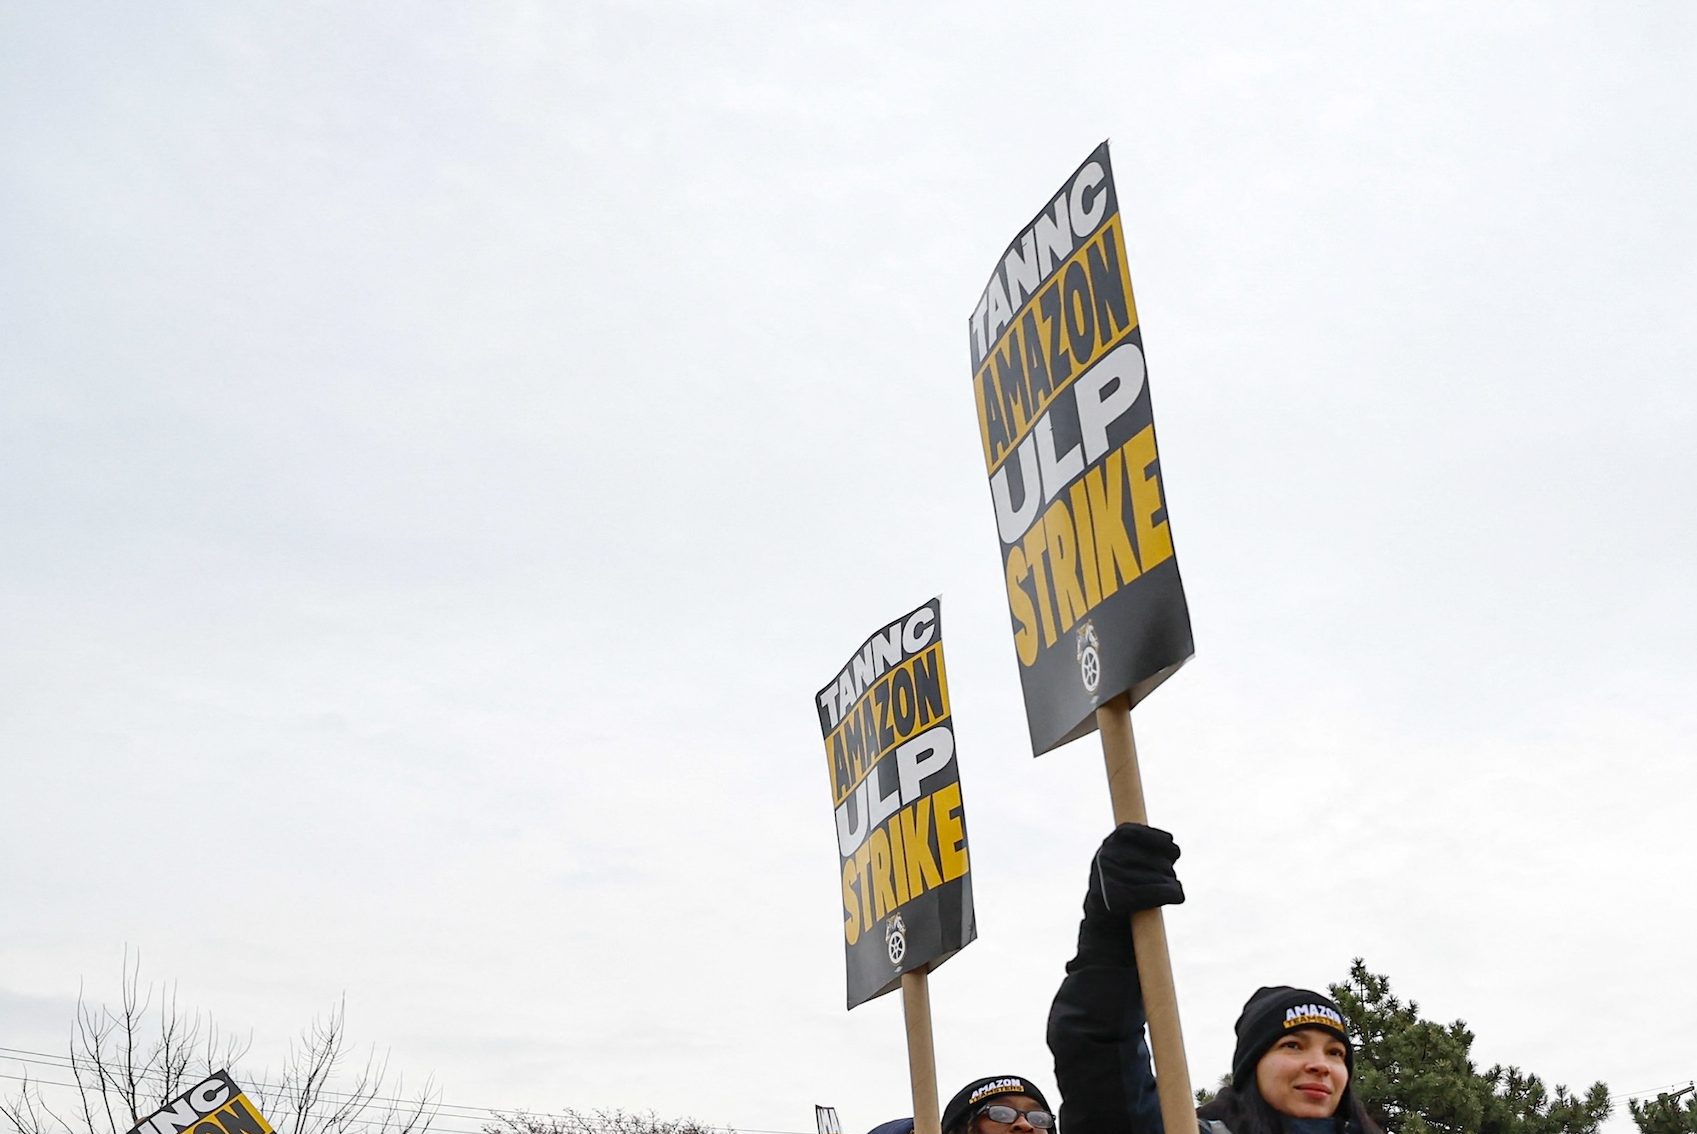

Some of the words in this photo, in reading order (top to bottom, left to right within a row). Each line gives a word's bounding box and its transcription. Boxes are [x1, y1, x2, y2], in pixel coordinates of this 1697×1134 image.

[972, 161, 1108, 363] TANNC
[982, 224, 1130, 462] AMAZON
[990, 343, 1145, 544] ULP
[1006, 423, 1173, 668] STRIKE
[819, 607, 935, 729] TANNC
[832, 648, 944, 798] AMAZON
[835, 726, 955, 857] ULP
[842, 781, 970, 946] STRIKE
[971, 1078, 1021, 1098] AMAZON
[1286, 1004, 1342, 1025] AMAZON
